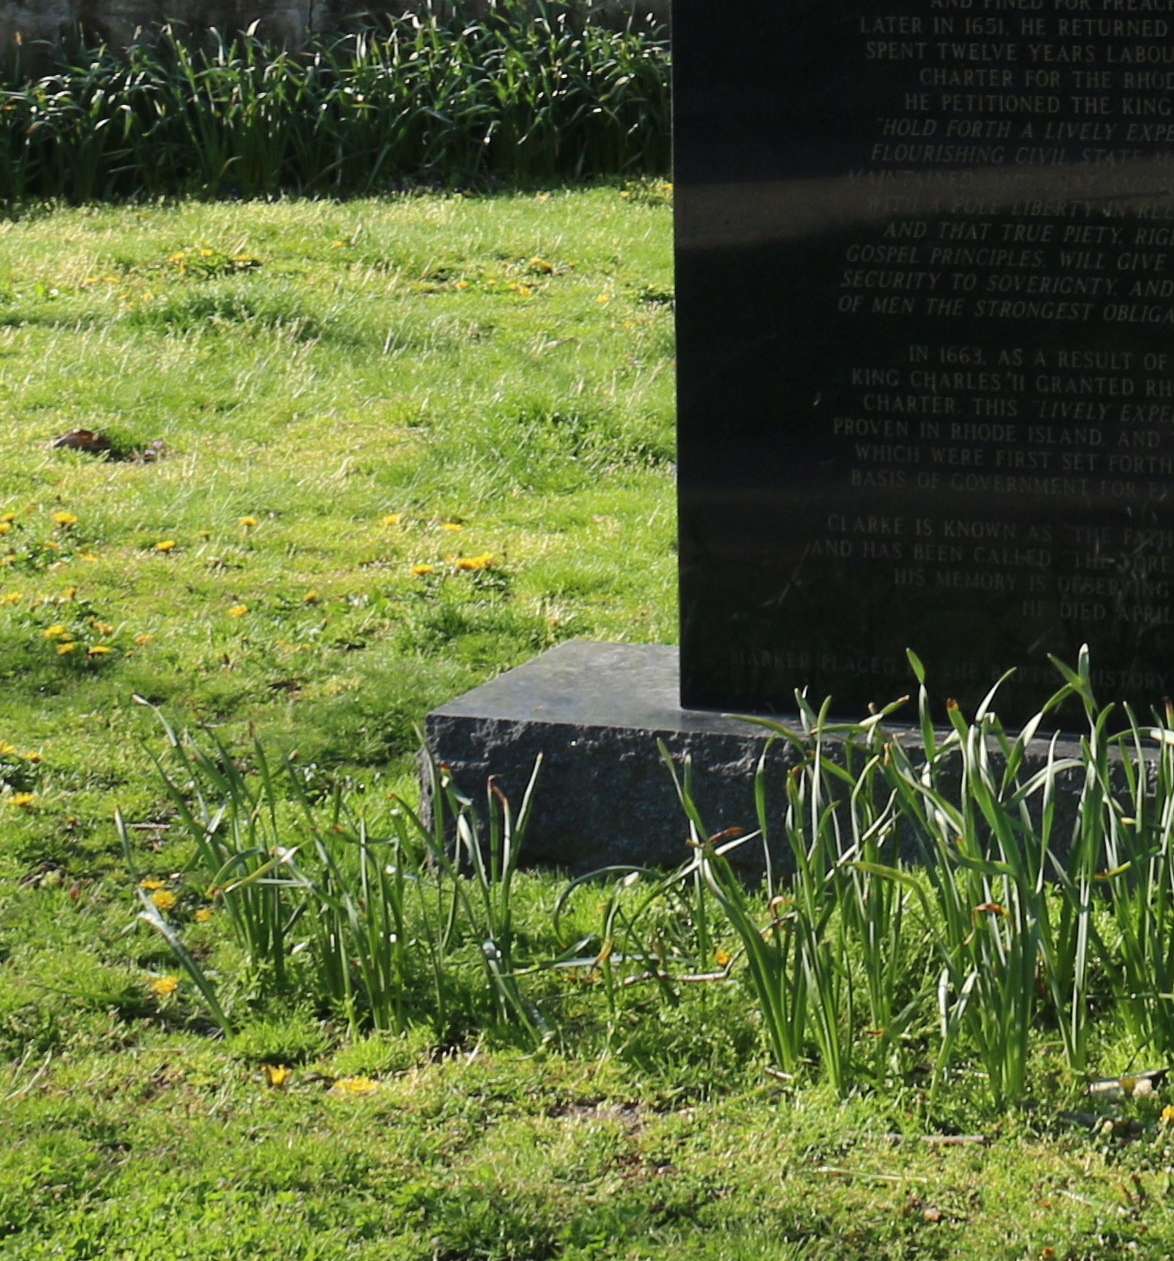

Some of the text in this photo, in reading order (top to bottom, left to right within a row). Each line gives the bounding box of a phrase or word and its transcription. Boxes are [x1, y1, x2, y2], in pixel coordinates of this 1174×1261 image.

[859, 16, 921, 35] LATER
[1058, 18, 1168, 38] RETURNED
[865, 41, 926, 60] SPENT
[936, 42, 1016, 62] TWELVE
[1027, 43, 1094, 63] YEARS
[919, 68, 1012, 88] CHARTER
[941, 93, 1060, 114] PETITIONED
[1121, 96, 1171, 116] KING
[945, 118, 1011, 138] FORTH
[1044, 120, 1117, 140] LIVELY
[871, 143, 1006, 164] FLOURISHING
[1011, 198, 1096, 219] LIBERTY
[935, 222, 991, 241] THAT
[998, 223, 1053, 243] TRUE
[846, 245, 921, 265] GOSPEL
[1056, 250, 1107, 270] WILL
[1115, 252, 1167, 272] GIVE
[840, 270, 940, 291] SECURITY
[973, 299, 1094, 321] STRONGEST
[1058, 350, 1133, 371] RESULT
[851, 368, 899, 387] KING
[909, 370, 1001, 392] CHARLES
[1035, 374, 1134, 396] GRANTED
[971, 398, 1017, 418] THIS
[833, 418, 1016, 442] PROVEN RHODE
[854, 444, 919, 465] WHICH
[995, 450, 1051, 470] FIRST
[1107, 454, 1172, 475] FORTH
